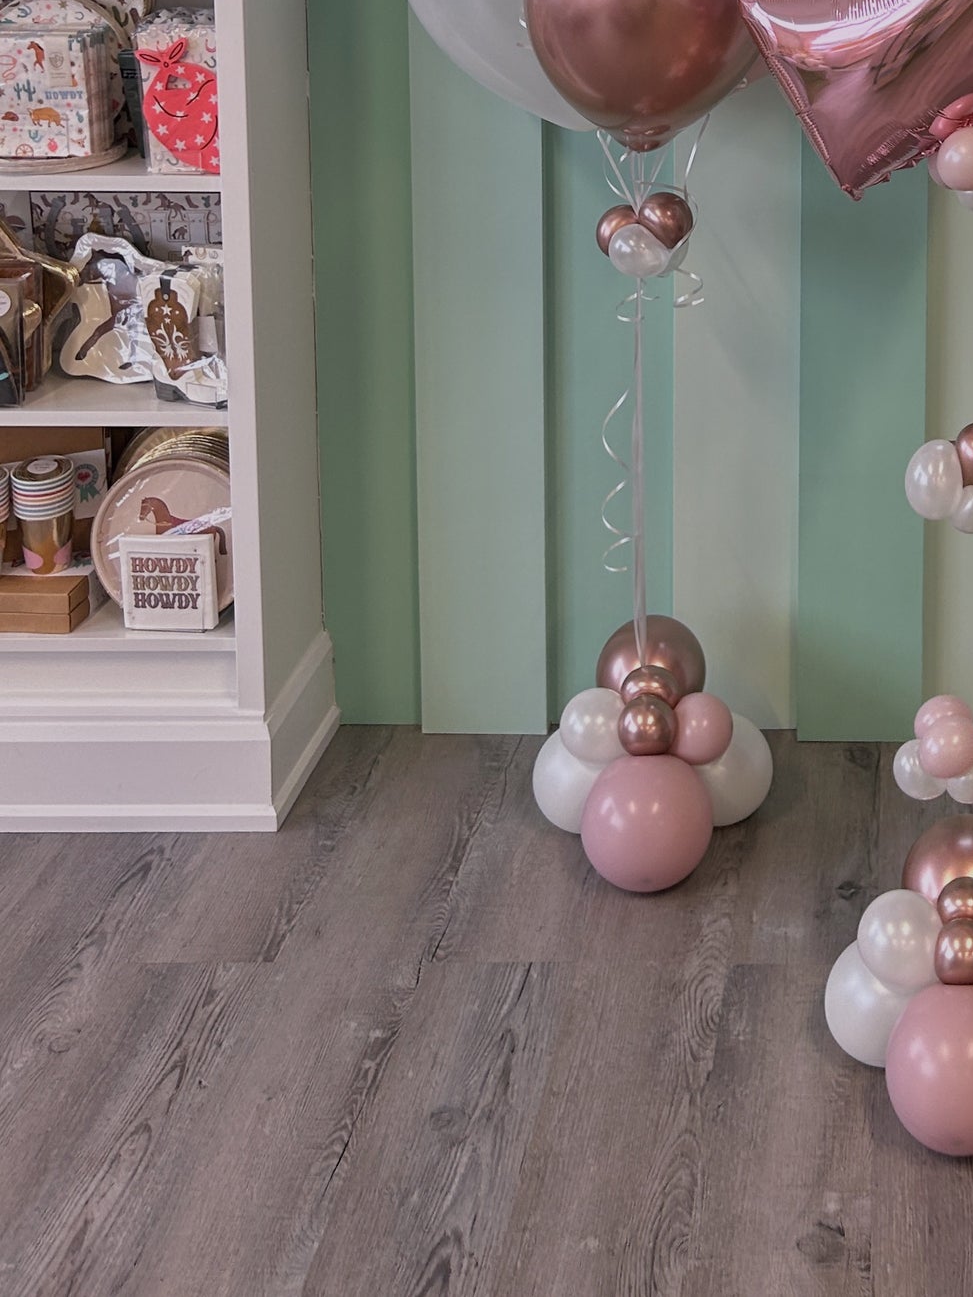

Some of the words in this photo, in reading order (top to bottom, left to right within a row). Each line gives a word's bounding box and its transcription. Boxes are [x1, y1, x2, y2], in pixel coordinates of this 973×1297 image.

[44, 90, 84, 101] HOWDY
[130, 556, 199, 574] HOWDY
[131, 574, 201, 592] HOWDY
[133, 592, 202, 610] HOWDY
